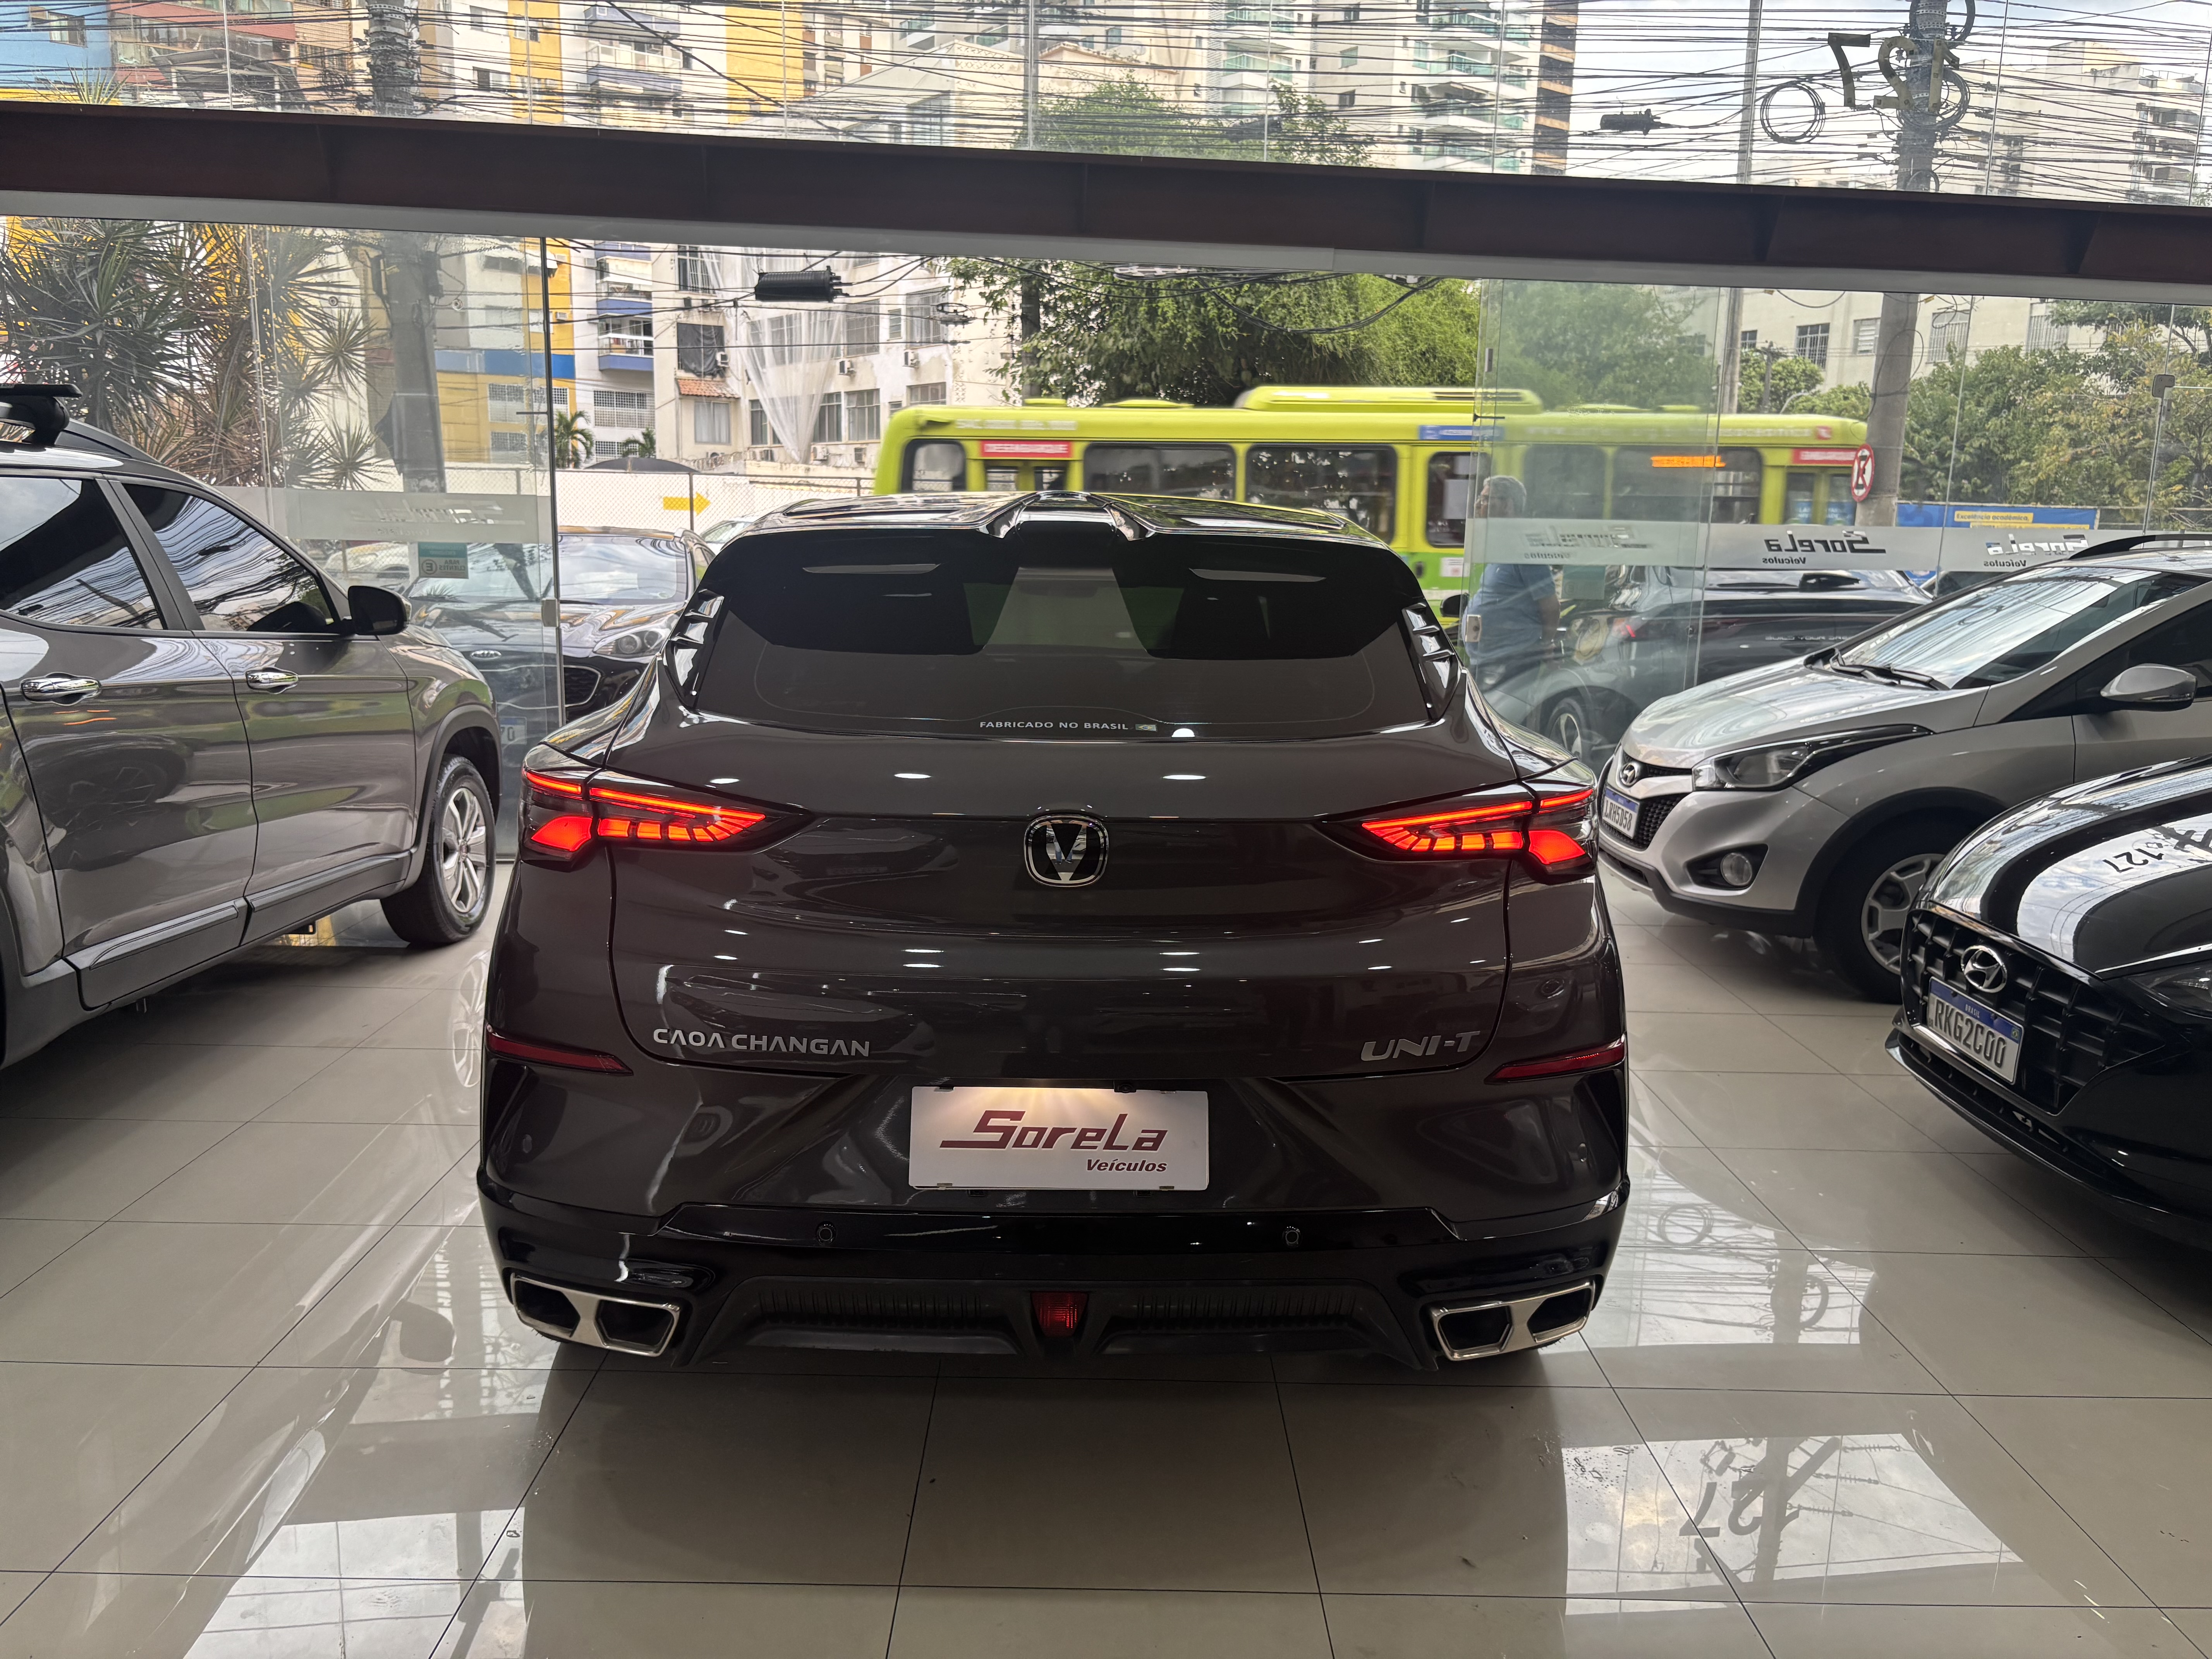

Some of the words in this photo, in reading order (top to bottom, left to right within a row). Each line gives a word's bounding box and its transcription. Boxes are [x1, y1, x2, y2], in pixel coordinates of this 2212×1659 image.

[1604, 800, 1632, 831] LRH5D58
[1965, 1004, 1980, 1018] BRASIL
[653, 1028, 725, 1048] CAOA
[732, 1034, 870, 1057] CHANGAN
[1361, 1031, 1480, 1061] UNI-T
[1934, 998, 2007, 1068] RKG2C00
[1086, 1158, 1168, 1173] Veículos
